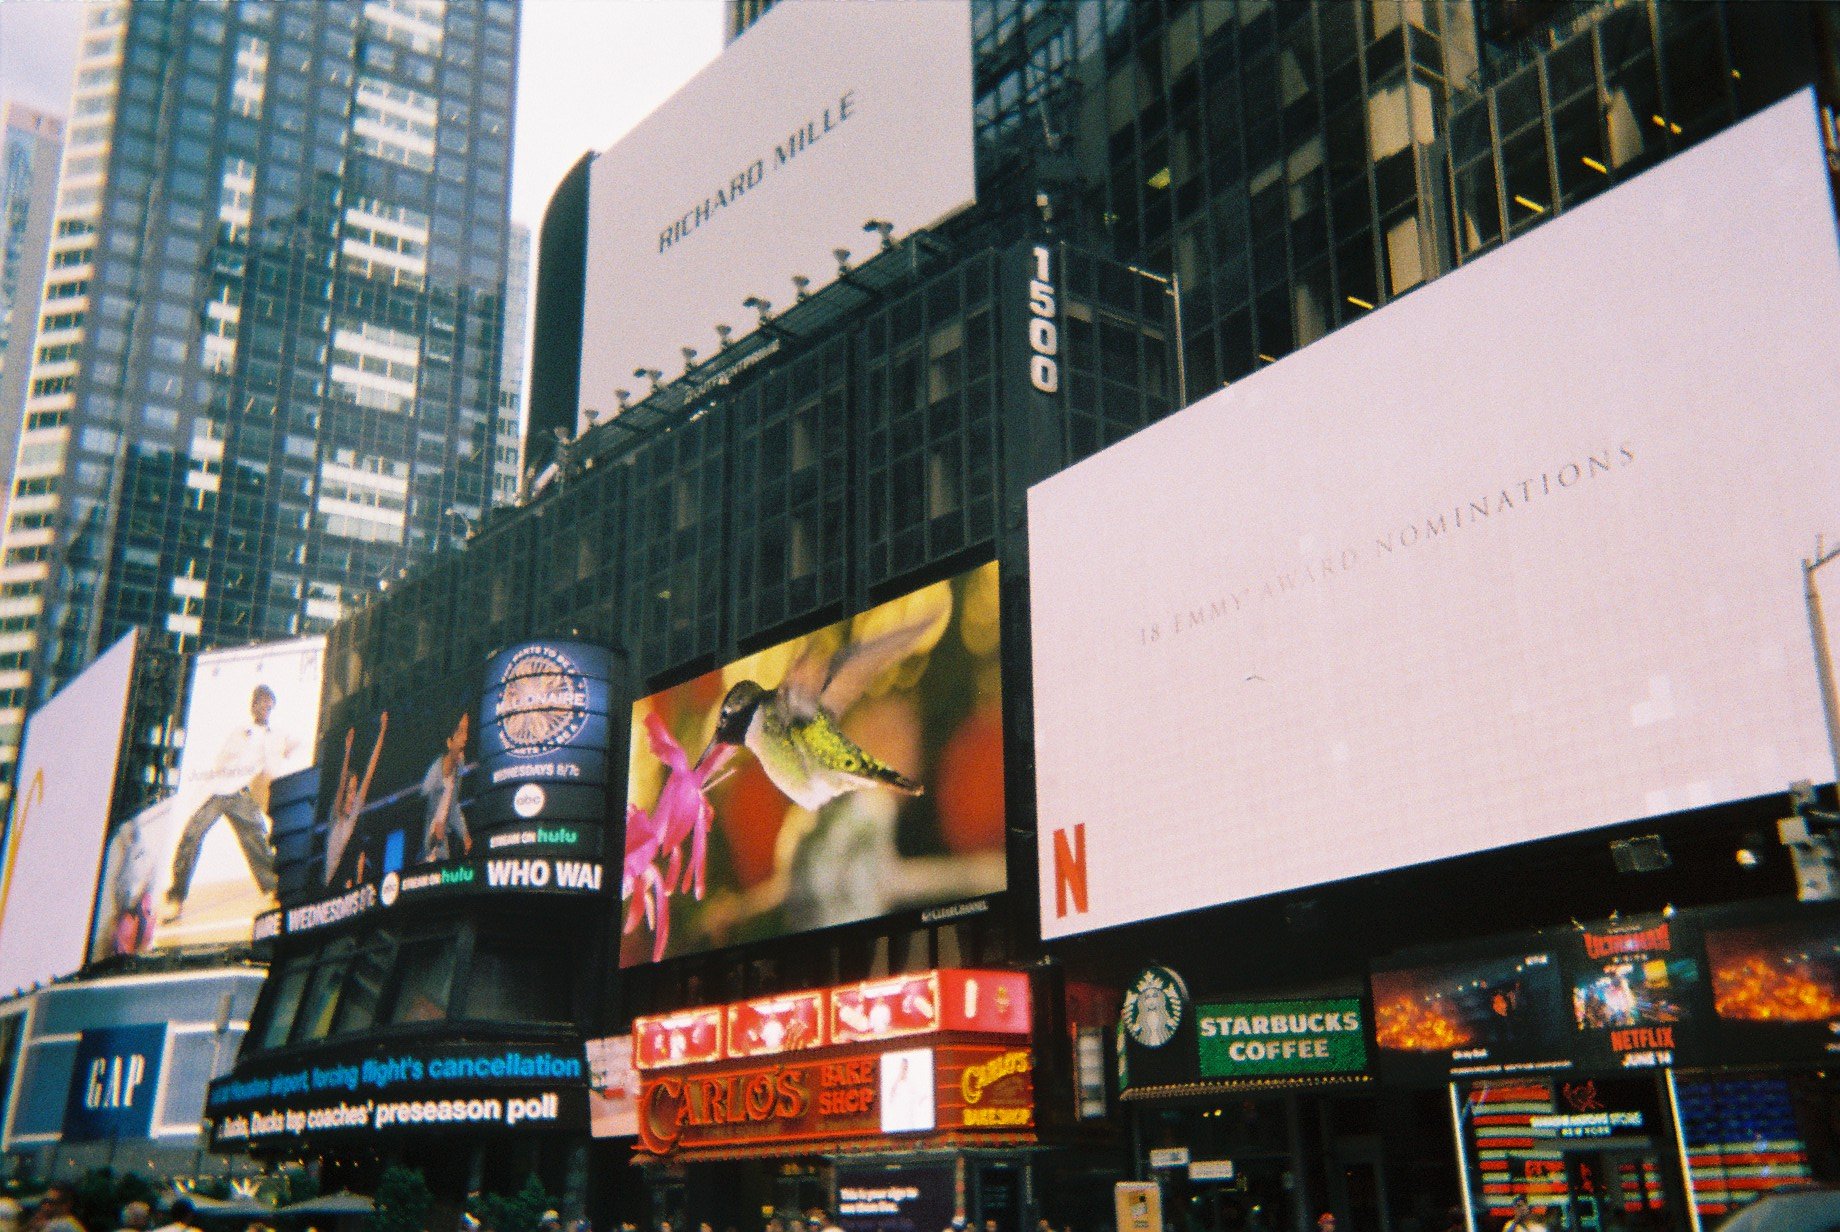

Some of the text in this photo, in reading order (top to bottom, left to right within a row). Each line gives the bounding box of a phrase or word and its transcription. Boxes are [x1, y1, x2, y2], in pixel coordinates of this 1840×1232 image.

[659, 89, 854, 254] RICHARD MILLE
[1029, 246, 1059, 394] 1500
[1140, 622, 1161, 646] 18
[1259, 547, 1359, 602] AWARD
[1375, 445, 1636, 558] NOMINATIONS
[537, 826, 578, 844] hulu
[441, 866, 475, 884] hulu
[487, 858, 551, 887] WHO
[1053, 822, 1088, 919] N
[1200, 1012, 1360, 1037] STARBUCKS
[1610, 1026, 1675, 1052] NETFLIX
[1228, 1038, 1330, 1062] COFFEE
[86, 1053, 146, 1109] GAP
[362, 1055, 424, 1088] flight's
[428, 1052, 582, 1078] cancellation
[821, 1062, 874, 1086] BAKE
[307, 1099, 374, 1130] coaches'
[375, 1098, 501, 1130] preseason
[506, 1092, 558, 1125] poll
[818, 1087, 874, 1115] SHOP
